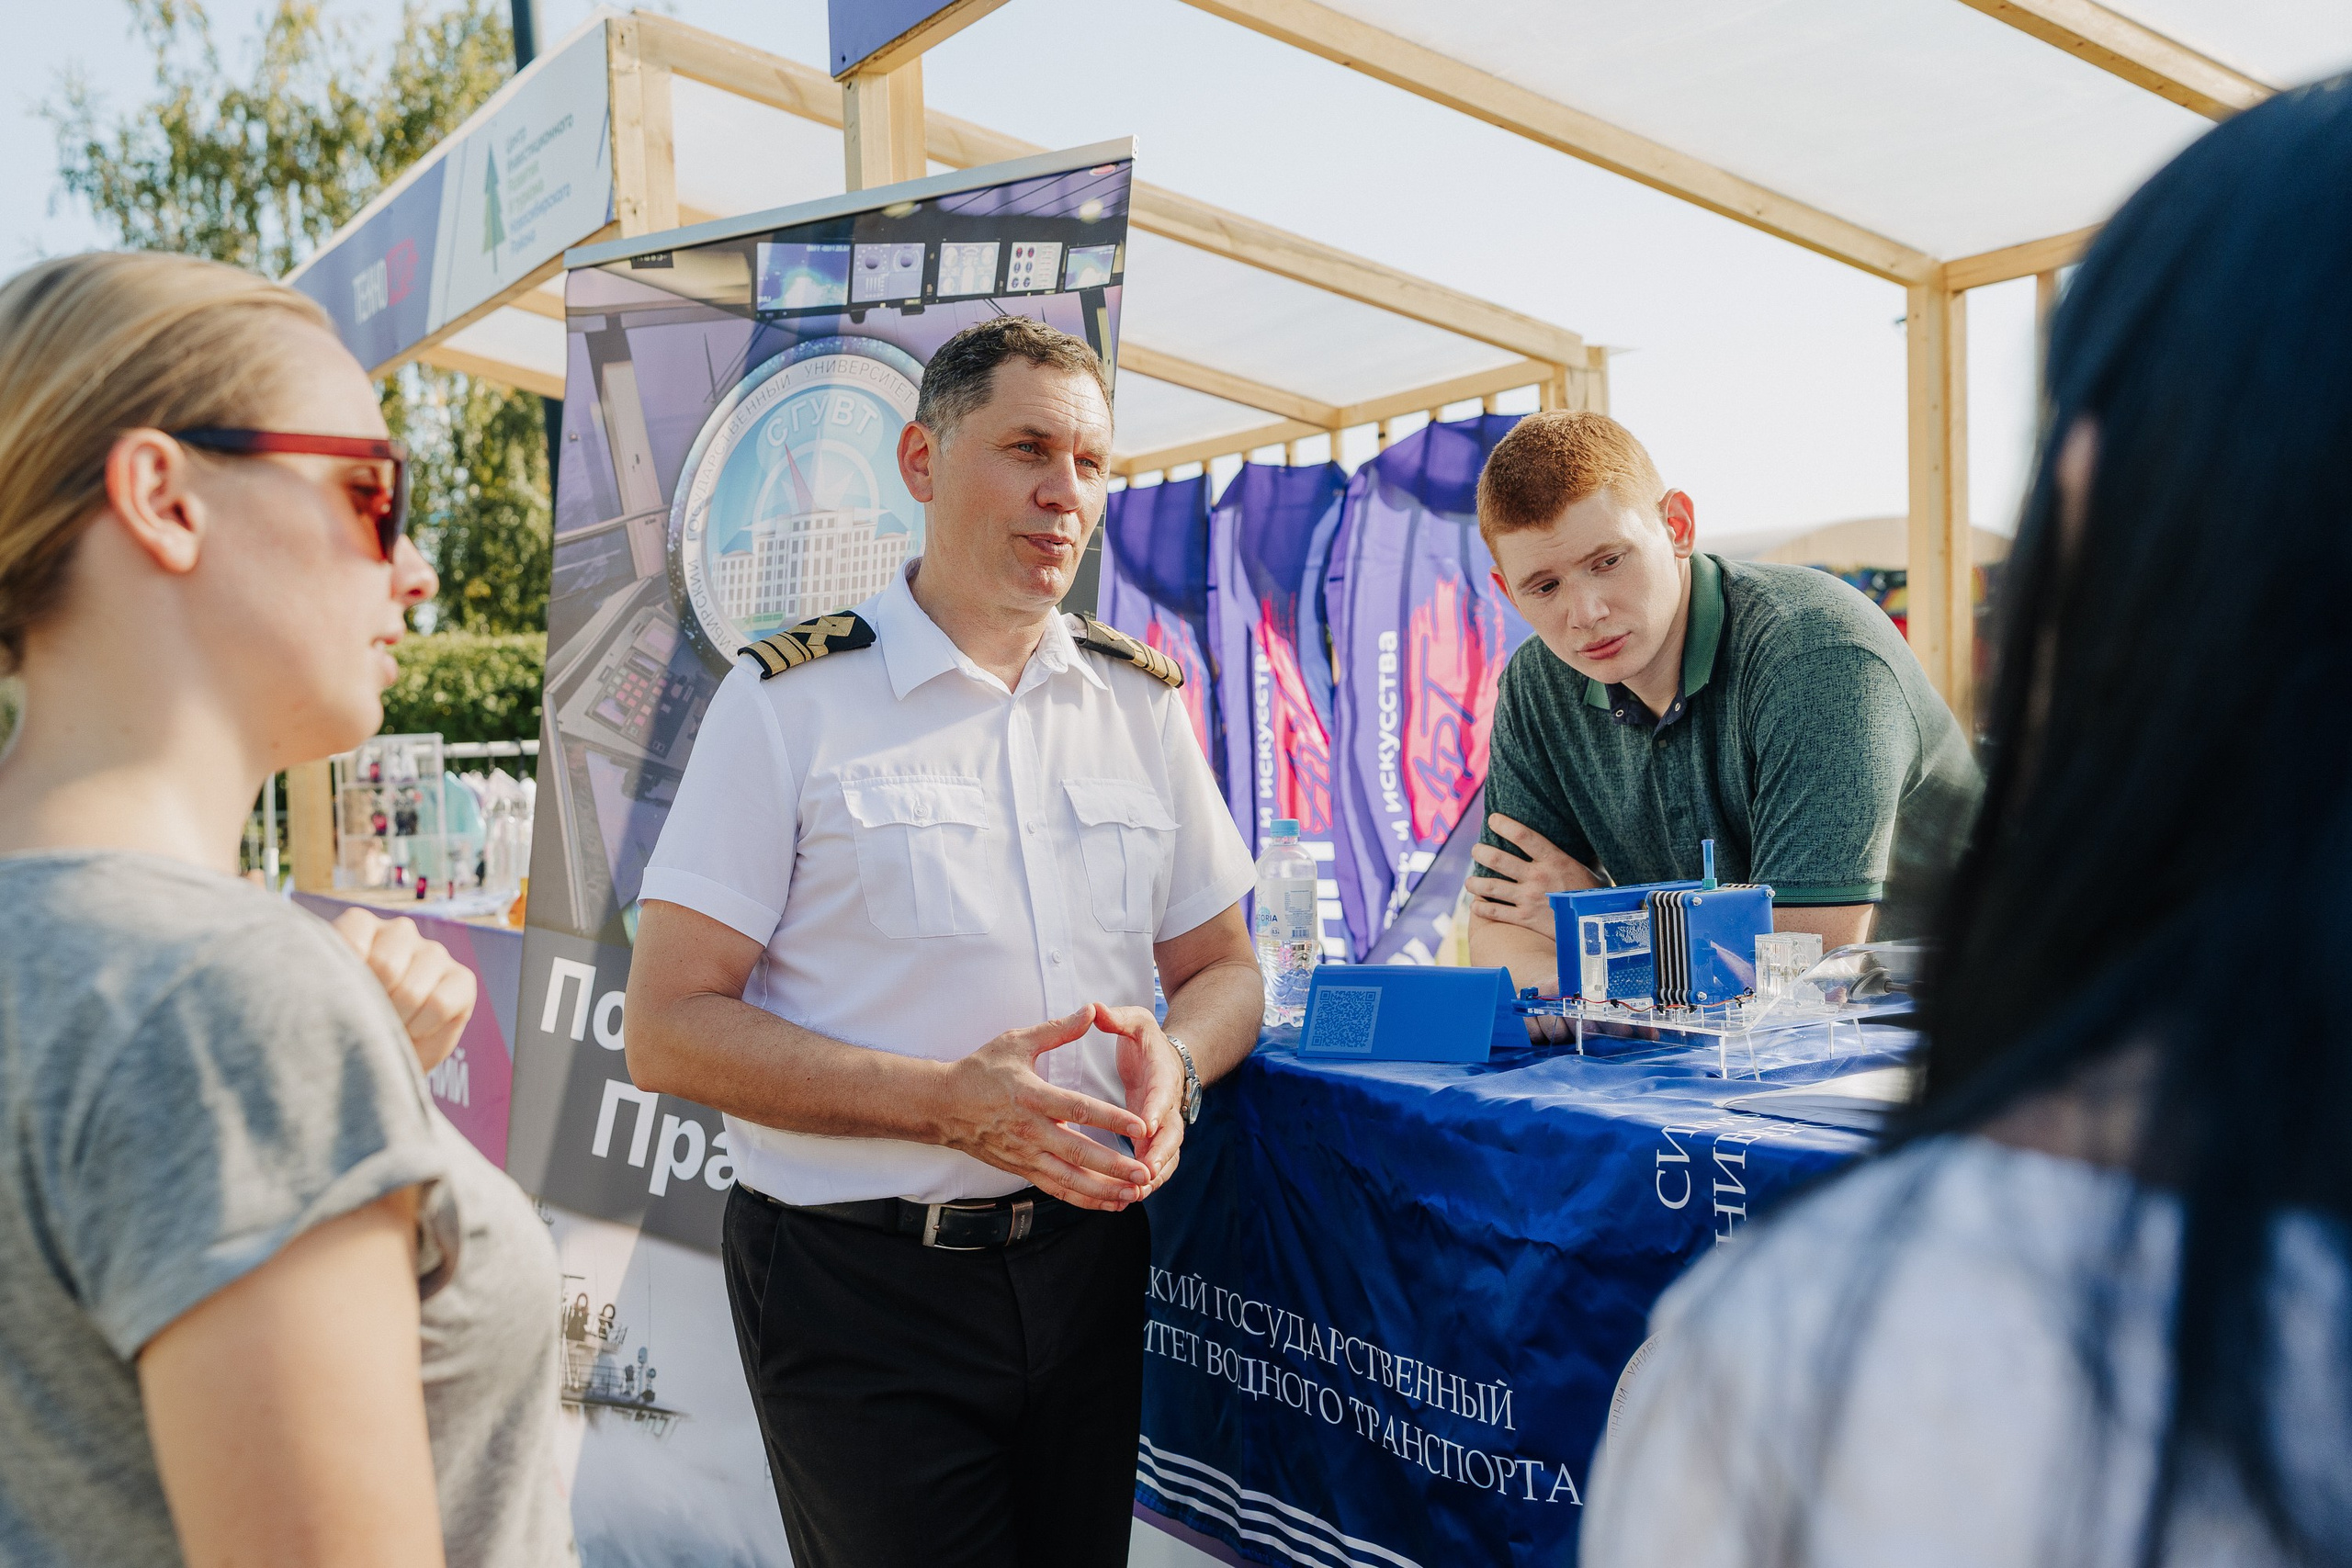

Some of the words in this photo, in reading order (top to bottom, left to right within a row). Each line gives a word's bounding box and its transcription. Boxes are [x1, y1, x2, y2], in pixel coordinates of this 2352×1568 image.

[766, 393, 878, 448] СГУВТ
[804, 359, 915, 404] УНИВЕРСИТЕТ
[1254, 645, 1275, 798] искусств
[1378, 630, 1403, 813] искусства
[540, 956, 626, 1051] По
[592, 1078, 736, 1197] Пра
[1145, 1265, 1208, 1315] КИЙ
[1214, 1286, 1516, 1431] ГОСУДАРСТВЕННЫЙ
[1627, 1334, 1666, 1379] УНИВЕ
[1205, 1339, 1344, 1425] ВОДНОГО
[1349, 1396, 1584, 1506] ТРАНСПОРТА
